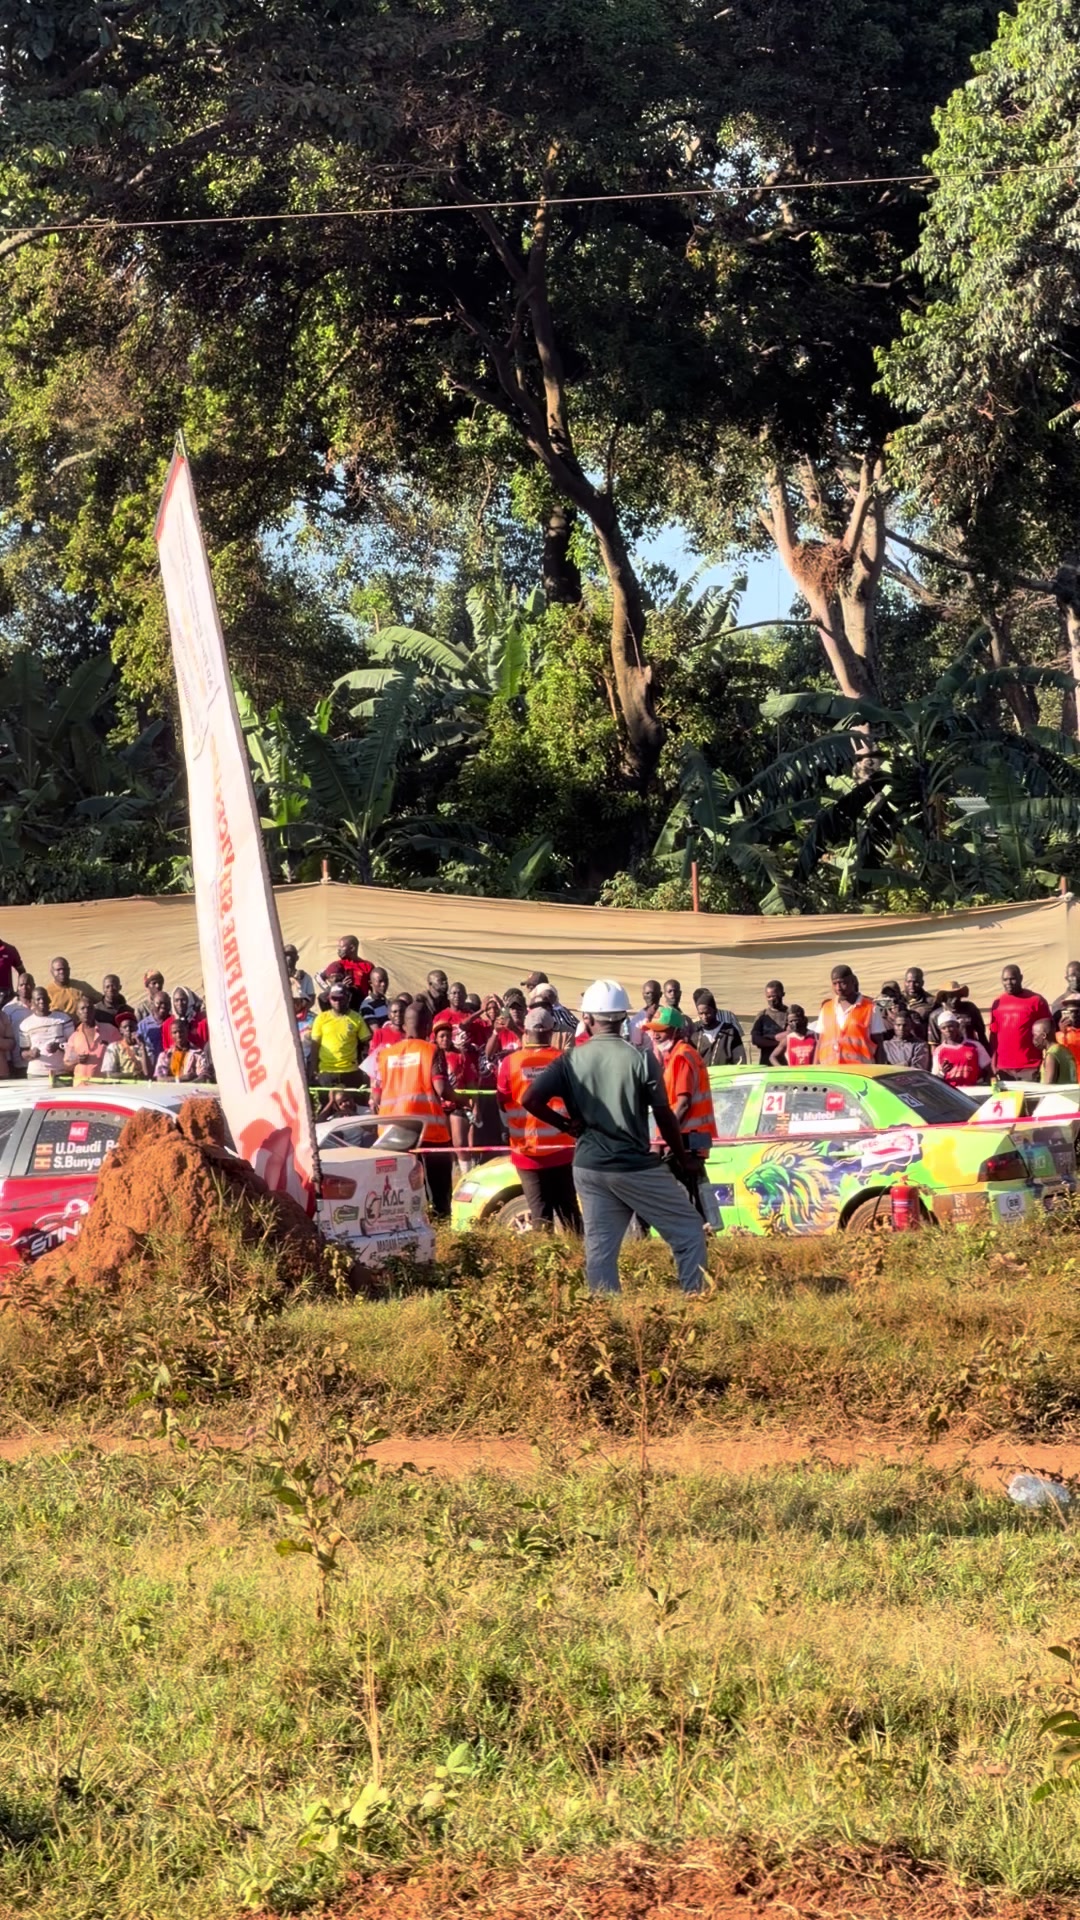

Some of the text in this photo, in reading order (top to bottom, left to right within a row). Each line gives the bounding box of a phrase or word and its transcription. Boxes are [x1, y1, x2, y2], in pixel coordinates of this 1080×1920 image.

[765, 1095, 783, 1111] 21
[55, 1140, 102, 1154] U.Daudi
[53, 1156, 101, 1171] S.Bunya
[31, 1220, 82, 1256] STIN
